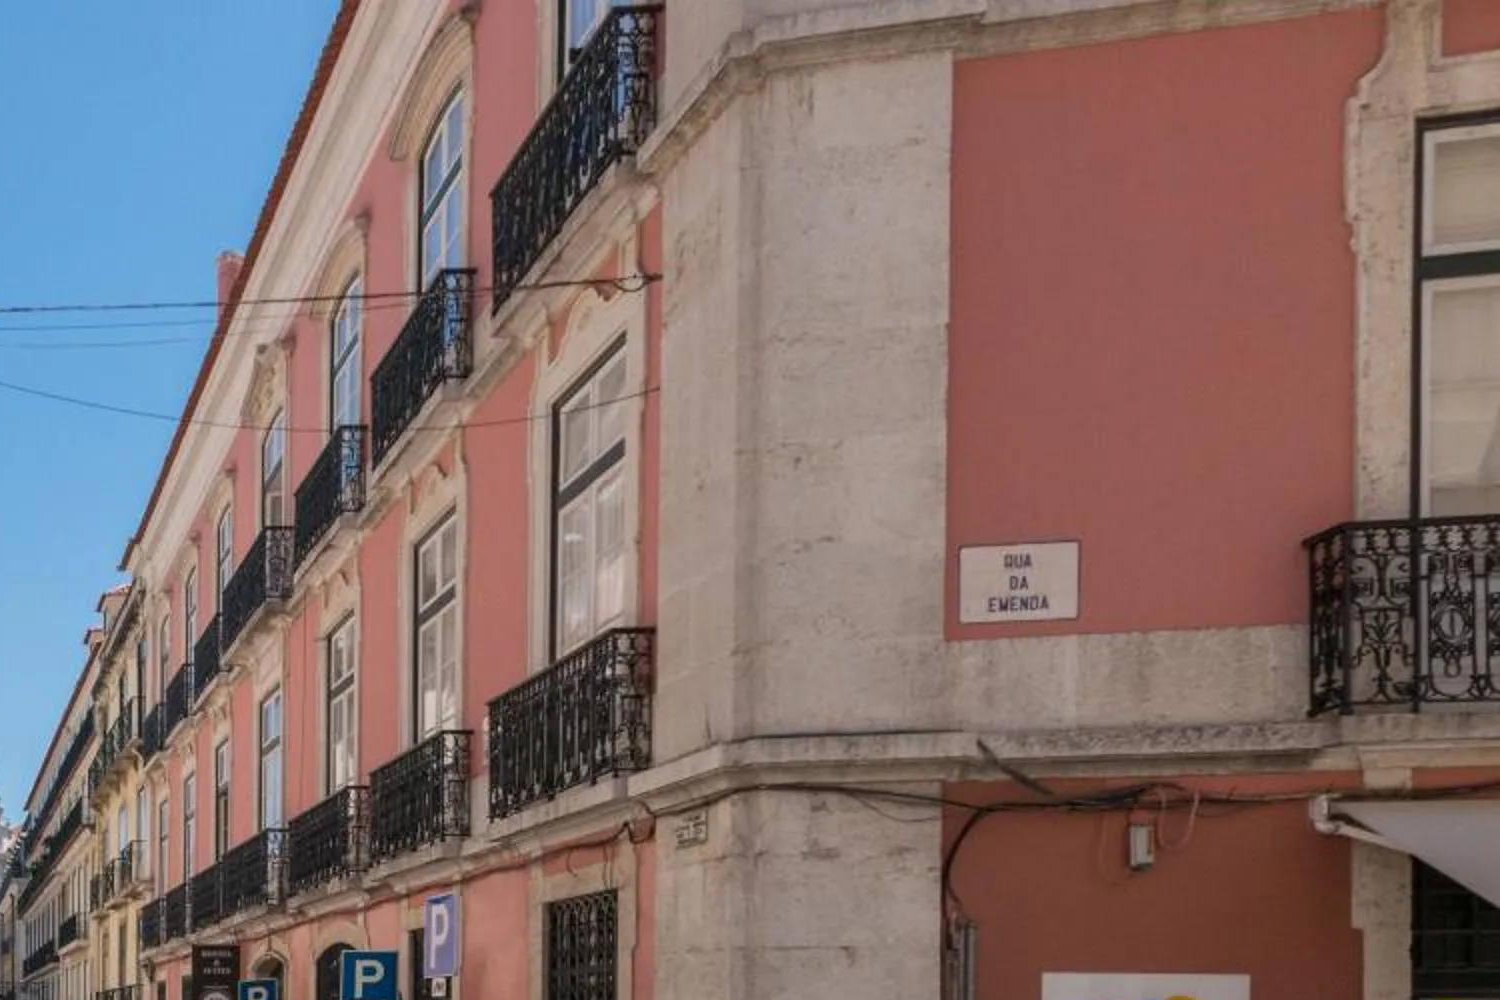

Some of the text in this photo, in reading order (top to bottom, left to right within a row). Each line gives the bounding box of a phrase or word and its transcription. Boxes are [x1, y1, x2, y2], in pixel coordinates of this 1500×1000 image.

[1003, 553, 1033, 569] RUA
[1008, 575, 1029, 591] DA
[986, 595, 1050, 613] EMENDA
[429, 903, 449, 970] P
[353, 959, 385, 999] P
